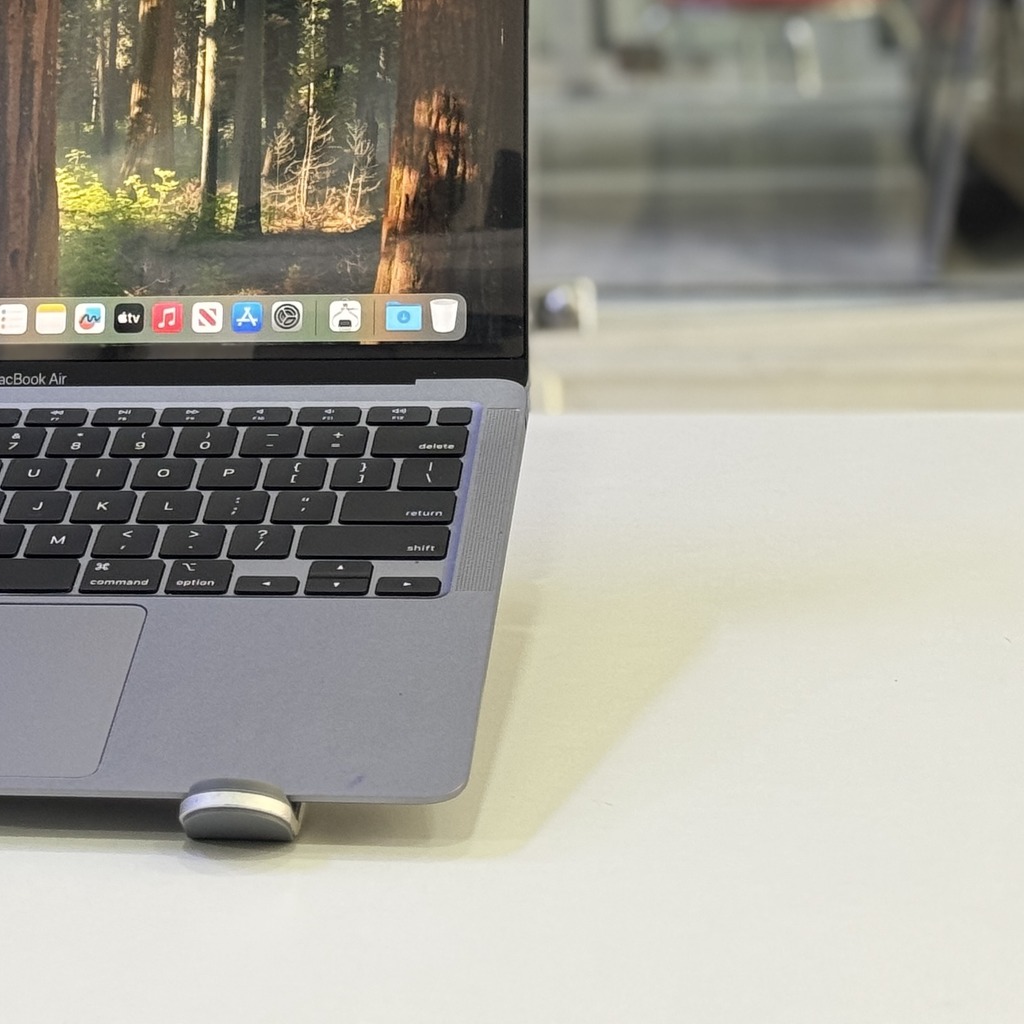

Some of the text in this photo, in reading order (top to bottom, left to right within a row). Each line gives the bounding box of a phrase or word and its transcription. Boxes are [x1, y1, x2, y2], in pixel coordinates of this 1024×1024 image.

[48, 372, 67, 386] Air
[8, 441, 19, 450] 7
[70, 441, 82, 450] 8
[134, 441, 146, 450] 9
[199, 441, 211, 450] 0
[27, 468, 41, 478] U
[95, 468, 101, 478] I
[157, 468, 170, 478] O
[222, 468, 235, 477] P
[32, 501, 43, 511] J
[96, 501, 109, 511] K
[164, 501, 173, 511] L
[50, 535, 66, 545] M
[407, 544, 435, 552] shift
[89, 578, 149, 586] command
[176, 579, 215, 587] option
